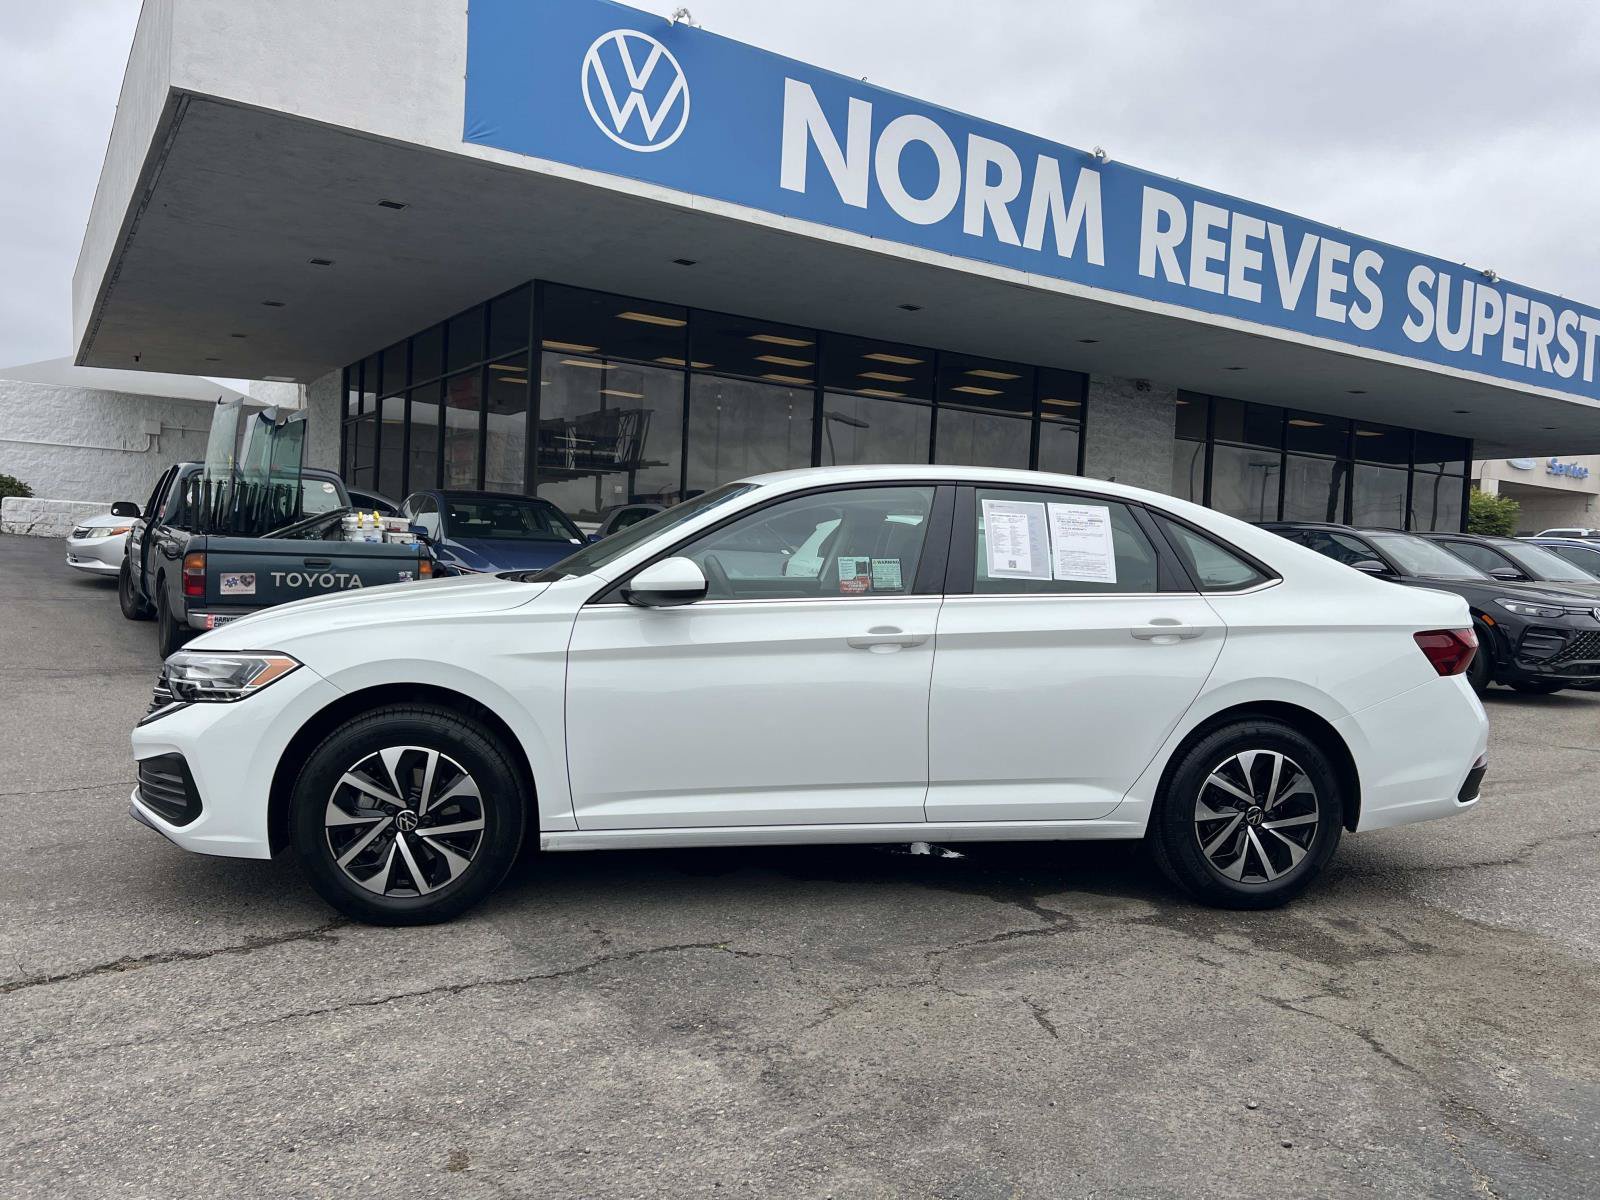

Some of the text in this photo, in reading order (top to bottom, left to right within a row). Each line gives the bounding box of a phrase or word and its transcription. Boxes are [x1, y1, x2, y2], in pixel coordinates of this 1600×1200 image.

[780, 76, 1600, 383] NORM REEVES SUPERST
[270, 572, 364, 588] TOYOTA
